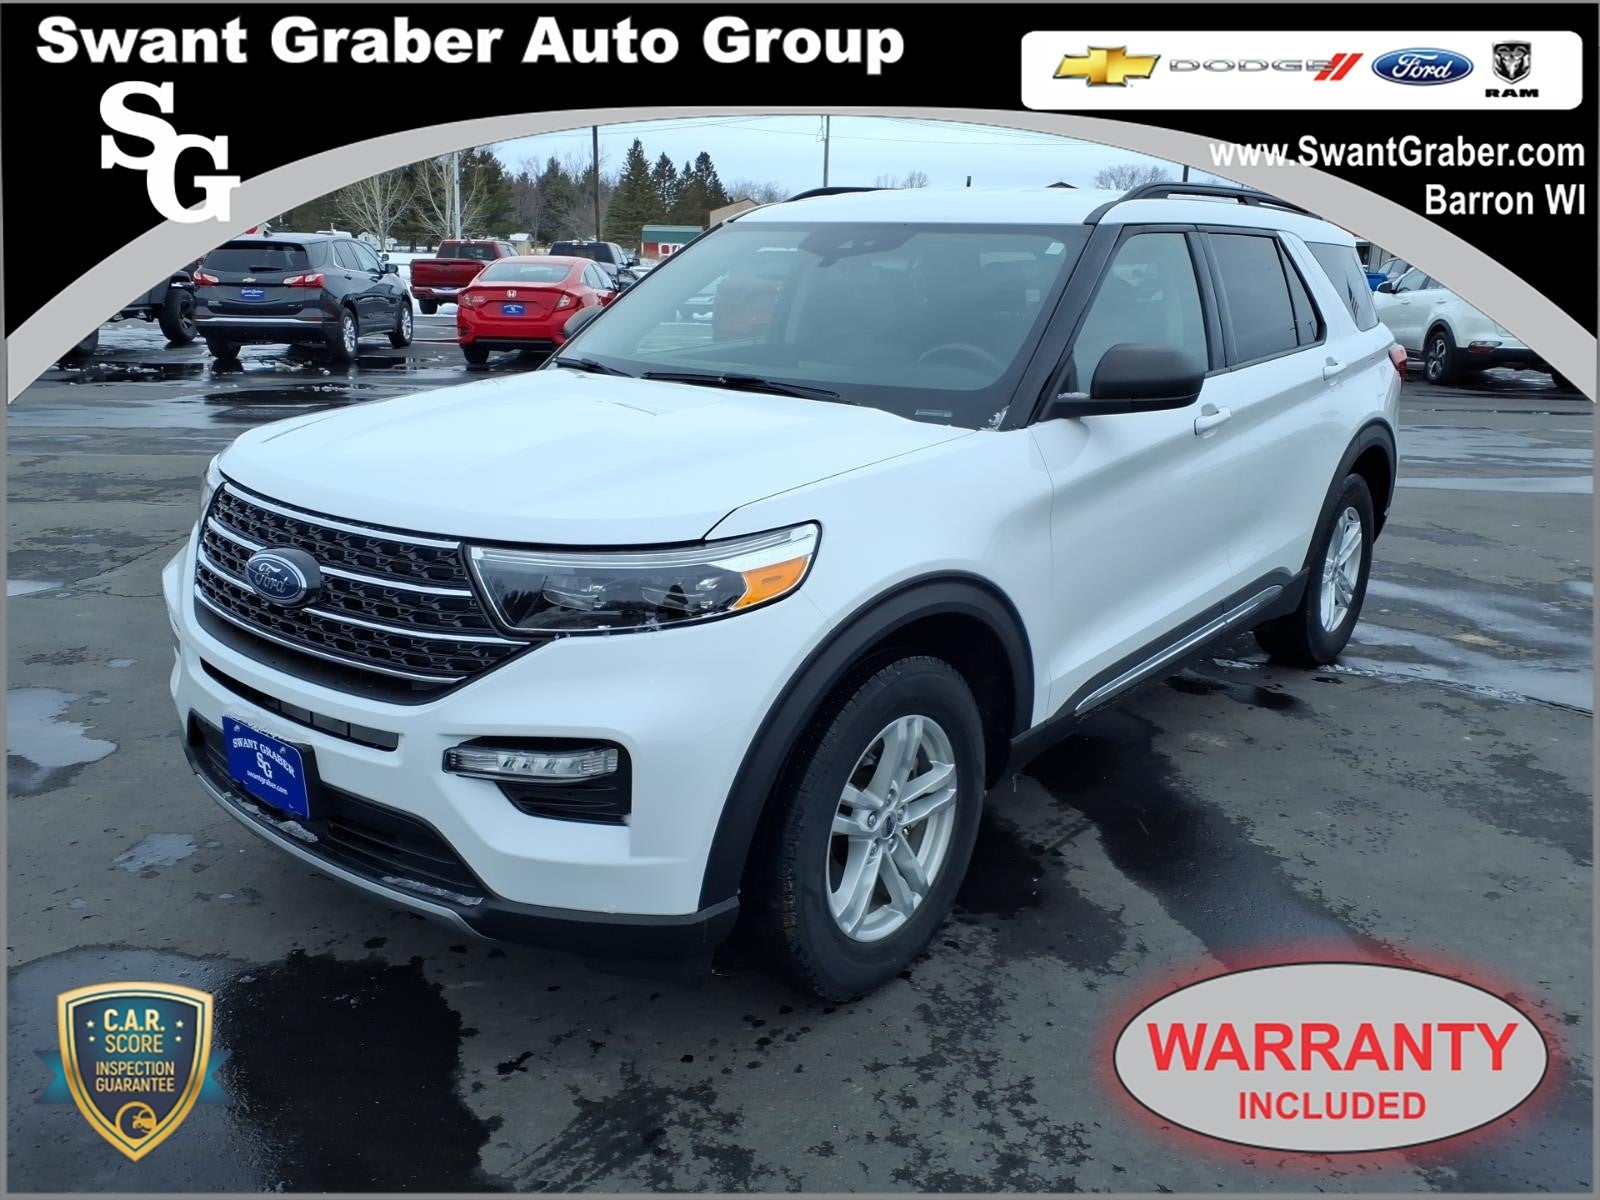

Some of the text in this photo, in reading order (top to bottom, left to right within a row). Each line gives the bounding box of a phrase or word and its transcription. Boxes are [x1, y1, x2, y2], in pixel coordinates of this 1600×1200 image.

[254, 562, 288, 593] Ford
[232, 737, 296, 778] SWANT GRABER
[246, 770, 288, 795] swantgraber.com
